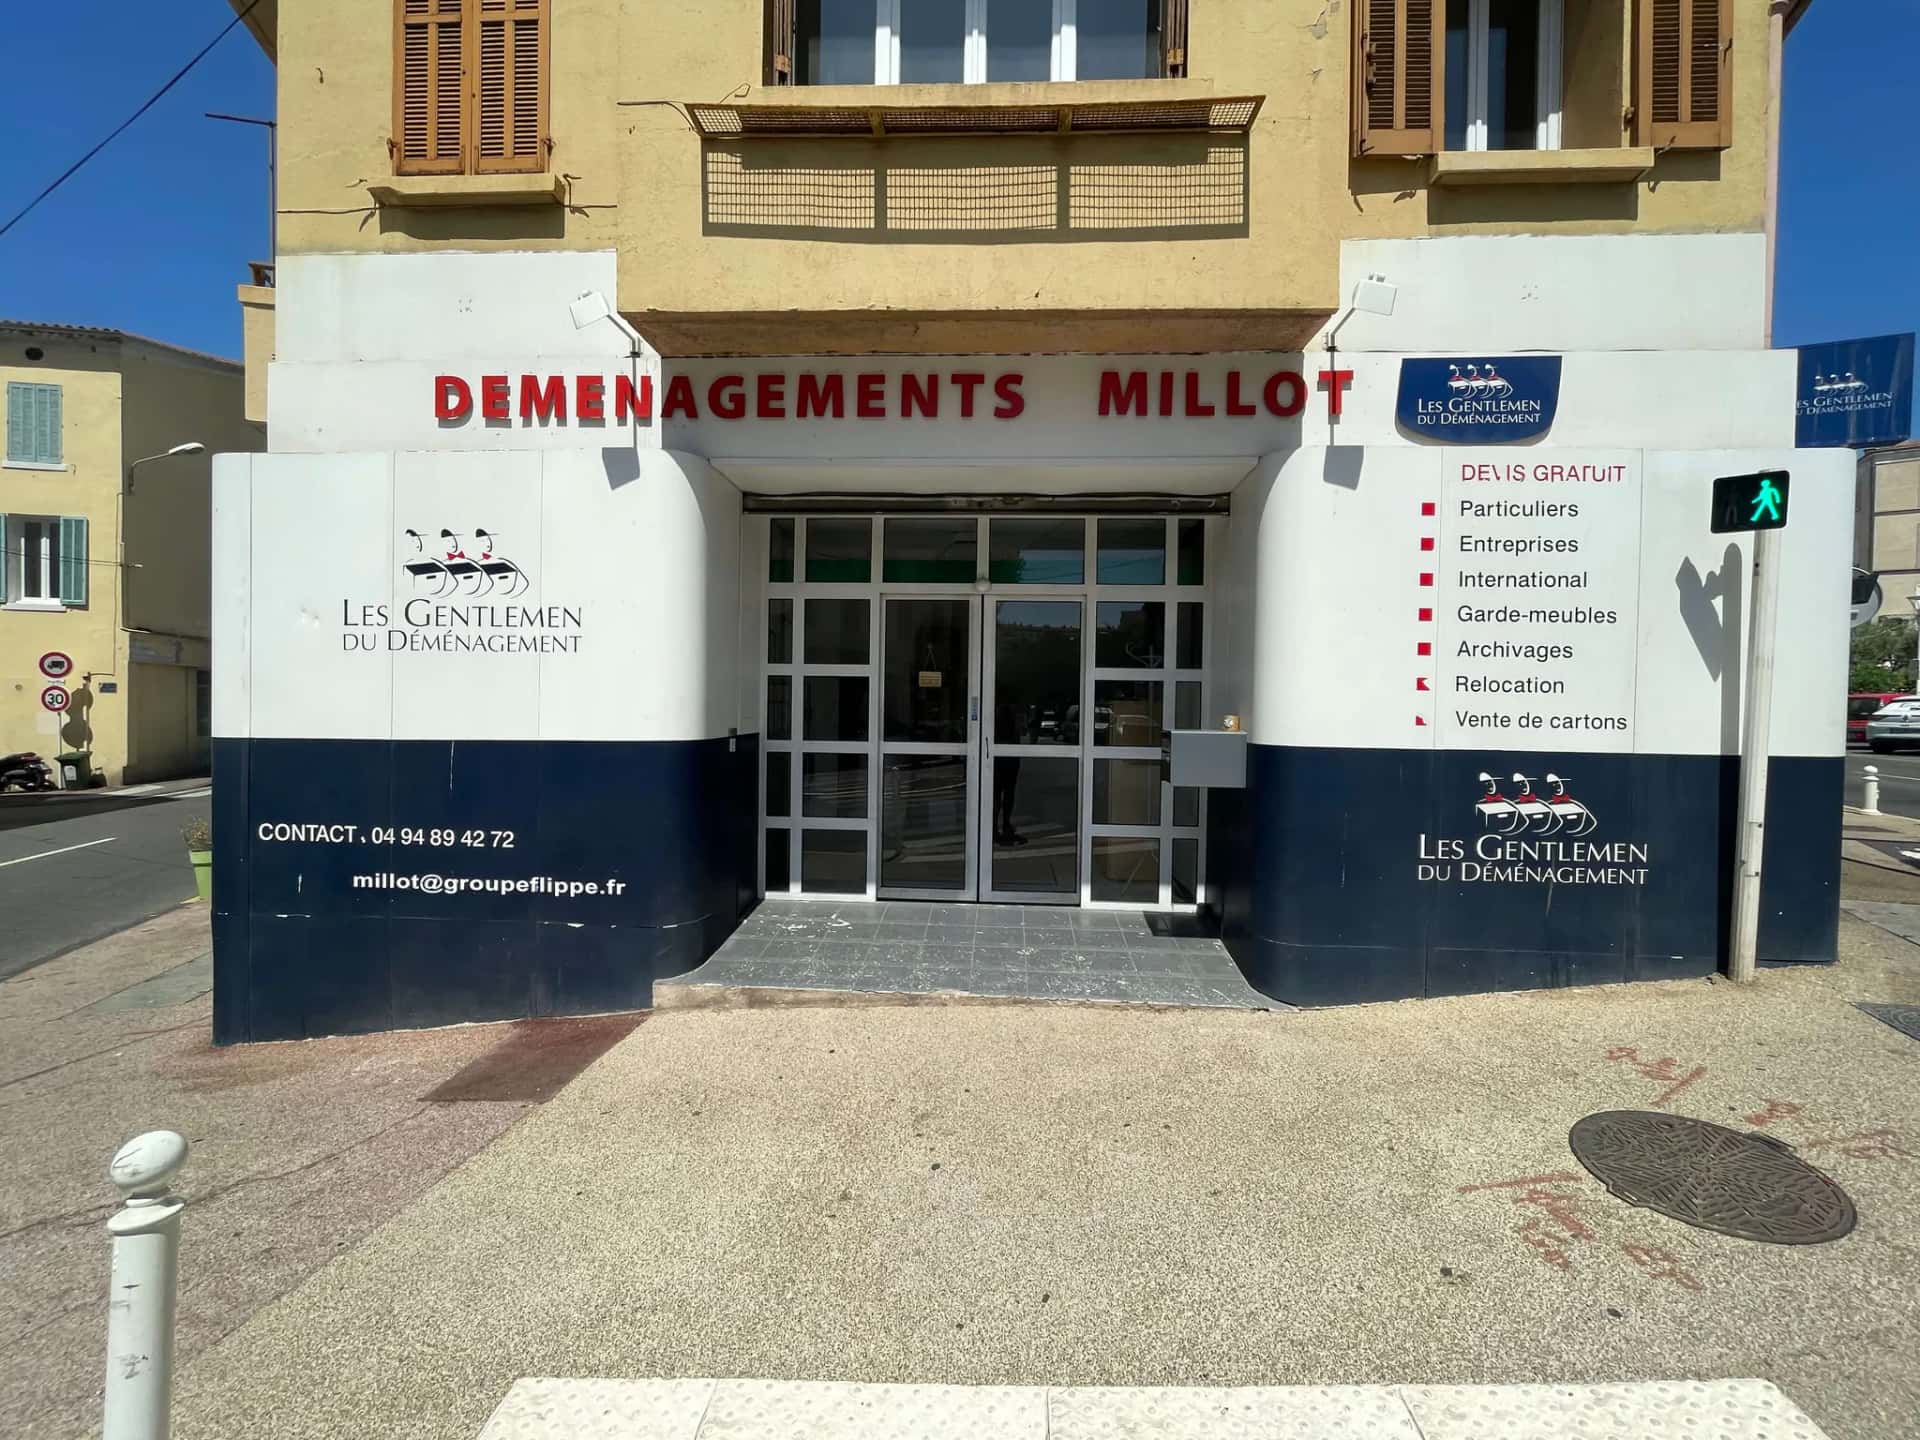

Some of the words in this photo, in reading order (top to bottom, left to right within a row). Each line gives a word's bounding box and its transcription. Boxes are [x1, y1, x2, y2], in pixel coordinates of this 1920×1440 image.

[434, 373, 1025, 419] DEMENAGEMENTS
[1098, 370, 1354, 417] MILLOT
[1418, 398, 1443, 413] LES
[1448, 398, 1541, 413] GENTLEMEN
[1417, 414, 1436, 425] DU
[1440, 412, 1541, 425] DÉMÉNAGEMENT
[1460, 500, 1579, 517] Particuliers
[1460, 535, 1579, 557] Entreprises
[1459, 570, 1587, 588] International
[343, 599, 389, 627] LES
[404, 598, 582, 628] GENTLEMEN
[1457, 605, 1617, 624] Garde-meubles
[343, 633, 377, 651] DU
[387, 629, 583, 653] DÉMÉNAGEMENT
[1457, 640, 1574, 663] Archivages
[1455, 675, 1565, 693] Relocation
[47, 693, 64, 705] 30
[1455, 711, 1511, 728] Vente
[1518, 712, 1543, 728] de
[1550, 714, 1628, 730] cartons
[371, 827, 396, 844] 04
[400, 827, 425, 846] 94
[430, 829, 455, 847] 89
[460, 830, 485, 848] 42
[490, 831, 515, 848] 72
[1419, 834, 1465, 860] LES
[1476, 834, 1648, 863] GENTLEMEN
[1418, 864, 1450, 881] DU
[1461, 861, 1649, 885] DÉMÉNAGEMENT
